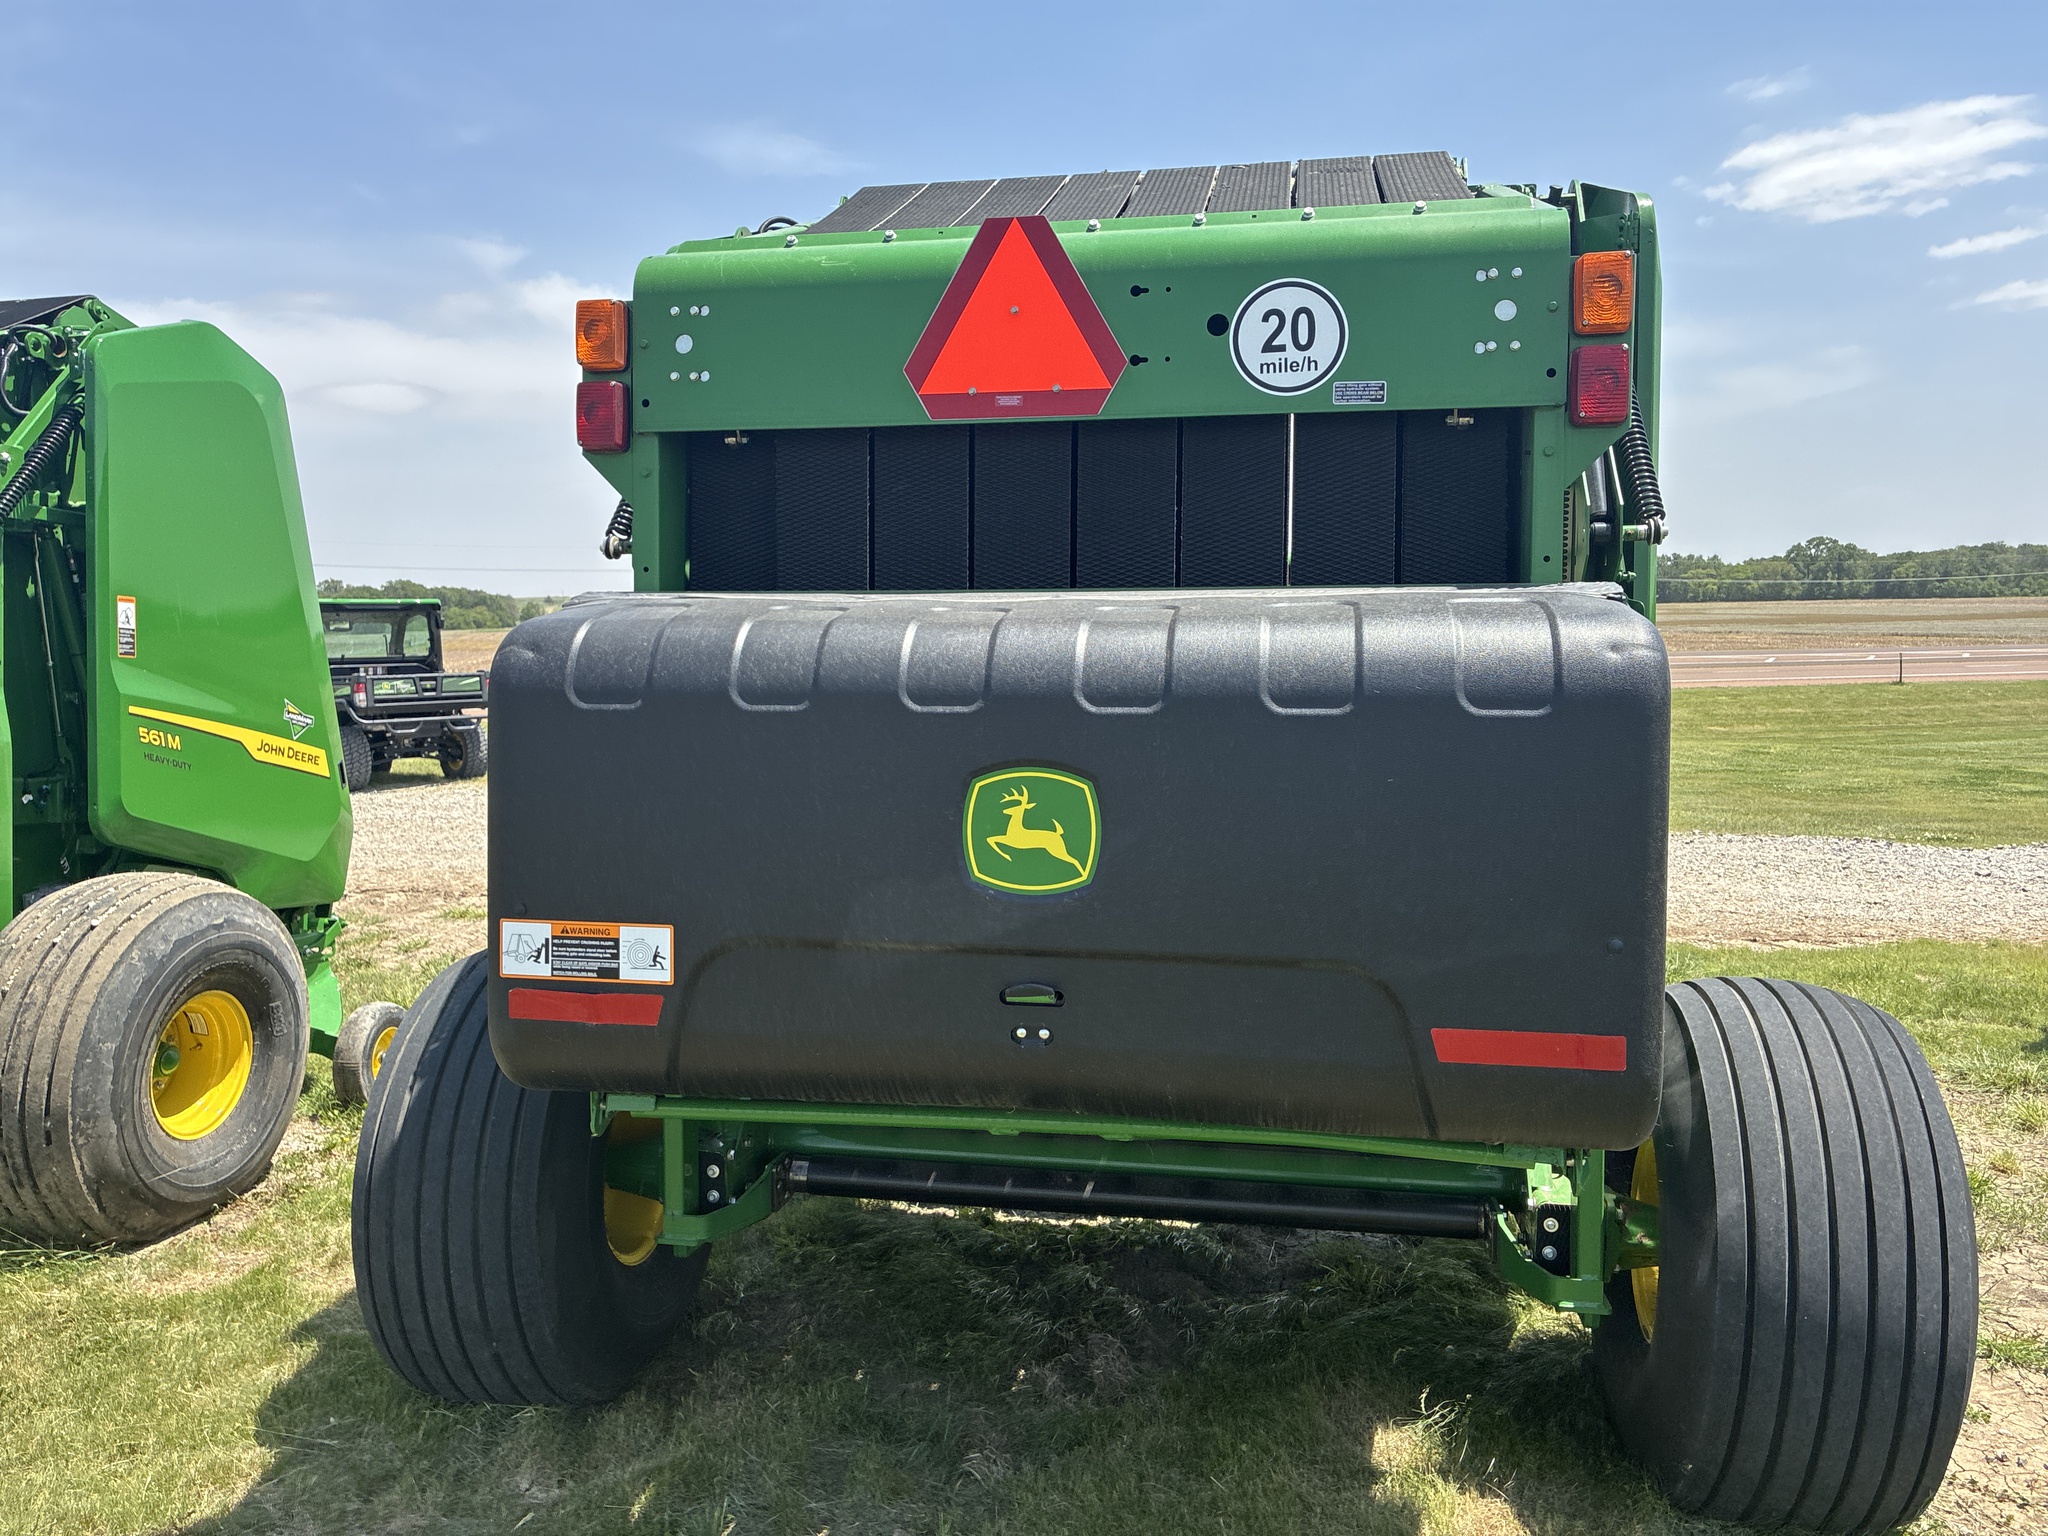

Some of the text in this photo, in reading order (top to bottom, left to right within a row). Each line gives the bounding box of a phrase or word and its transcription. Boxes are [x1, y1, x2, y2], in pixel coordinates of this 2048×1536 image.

[1260, 306, 1316, 353] 20
[1260, 356, 1318, 374] mile/h
[138, 726, 181, 751] 561 M
[256, 739, 320, 766] JOHN DEERE
[570, 927, 610, 936] WARNING
